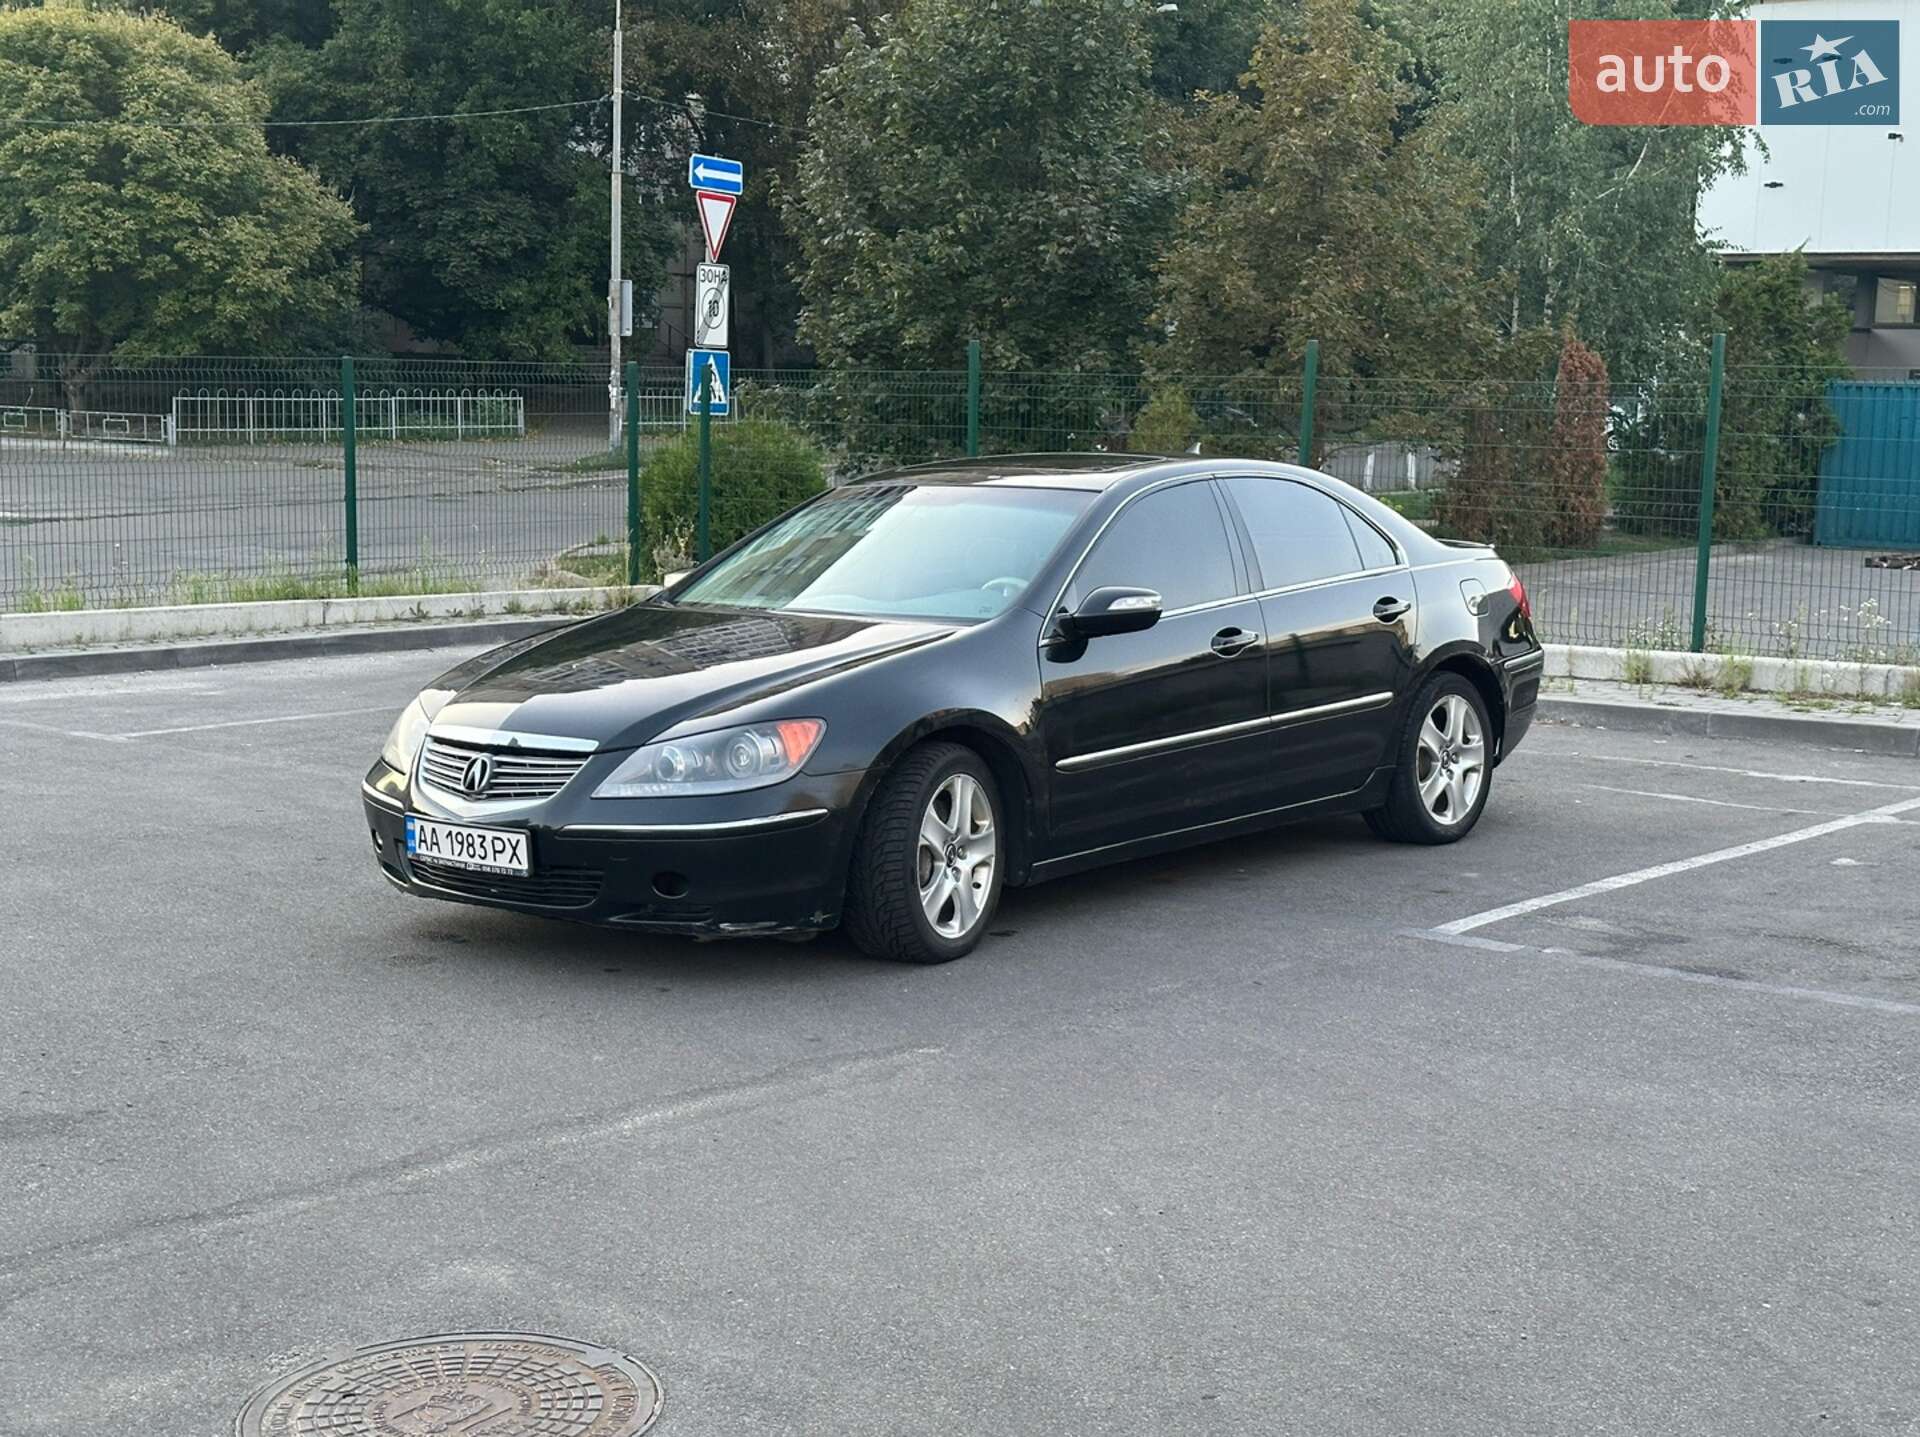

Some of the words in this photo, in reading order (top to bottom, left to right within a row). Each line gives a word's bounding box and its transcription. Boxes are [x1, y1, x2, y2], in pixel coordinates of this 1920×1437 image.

[699, 268, 728, 284] ЗОНА
[708, 299, 720, 317] 10
[418, 824, 442, 854] AA
[445, 829, 488, 860] 1983
[491, 835, 523, 866] PX
